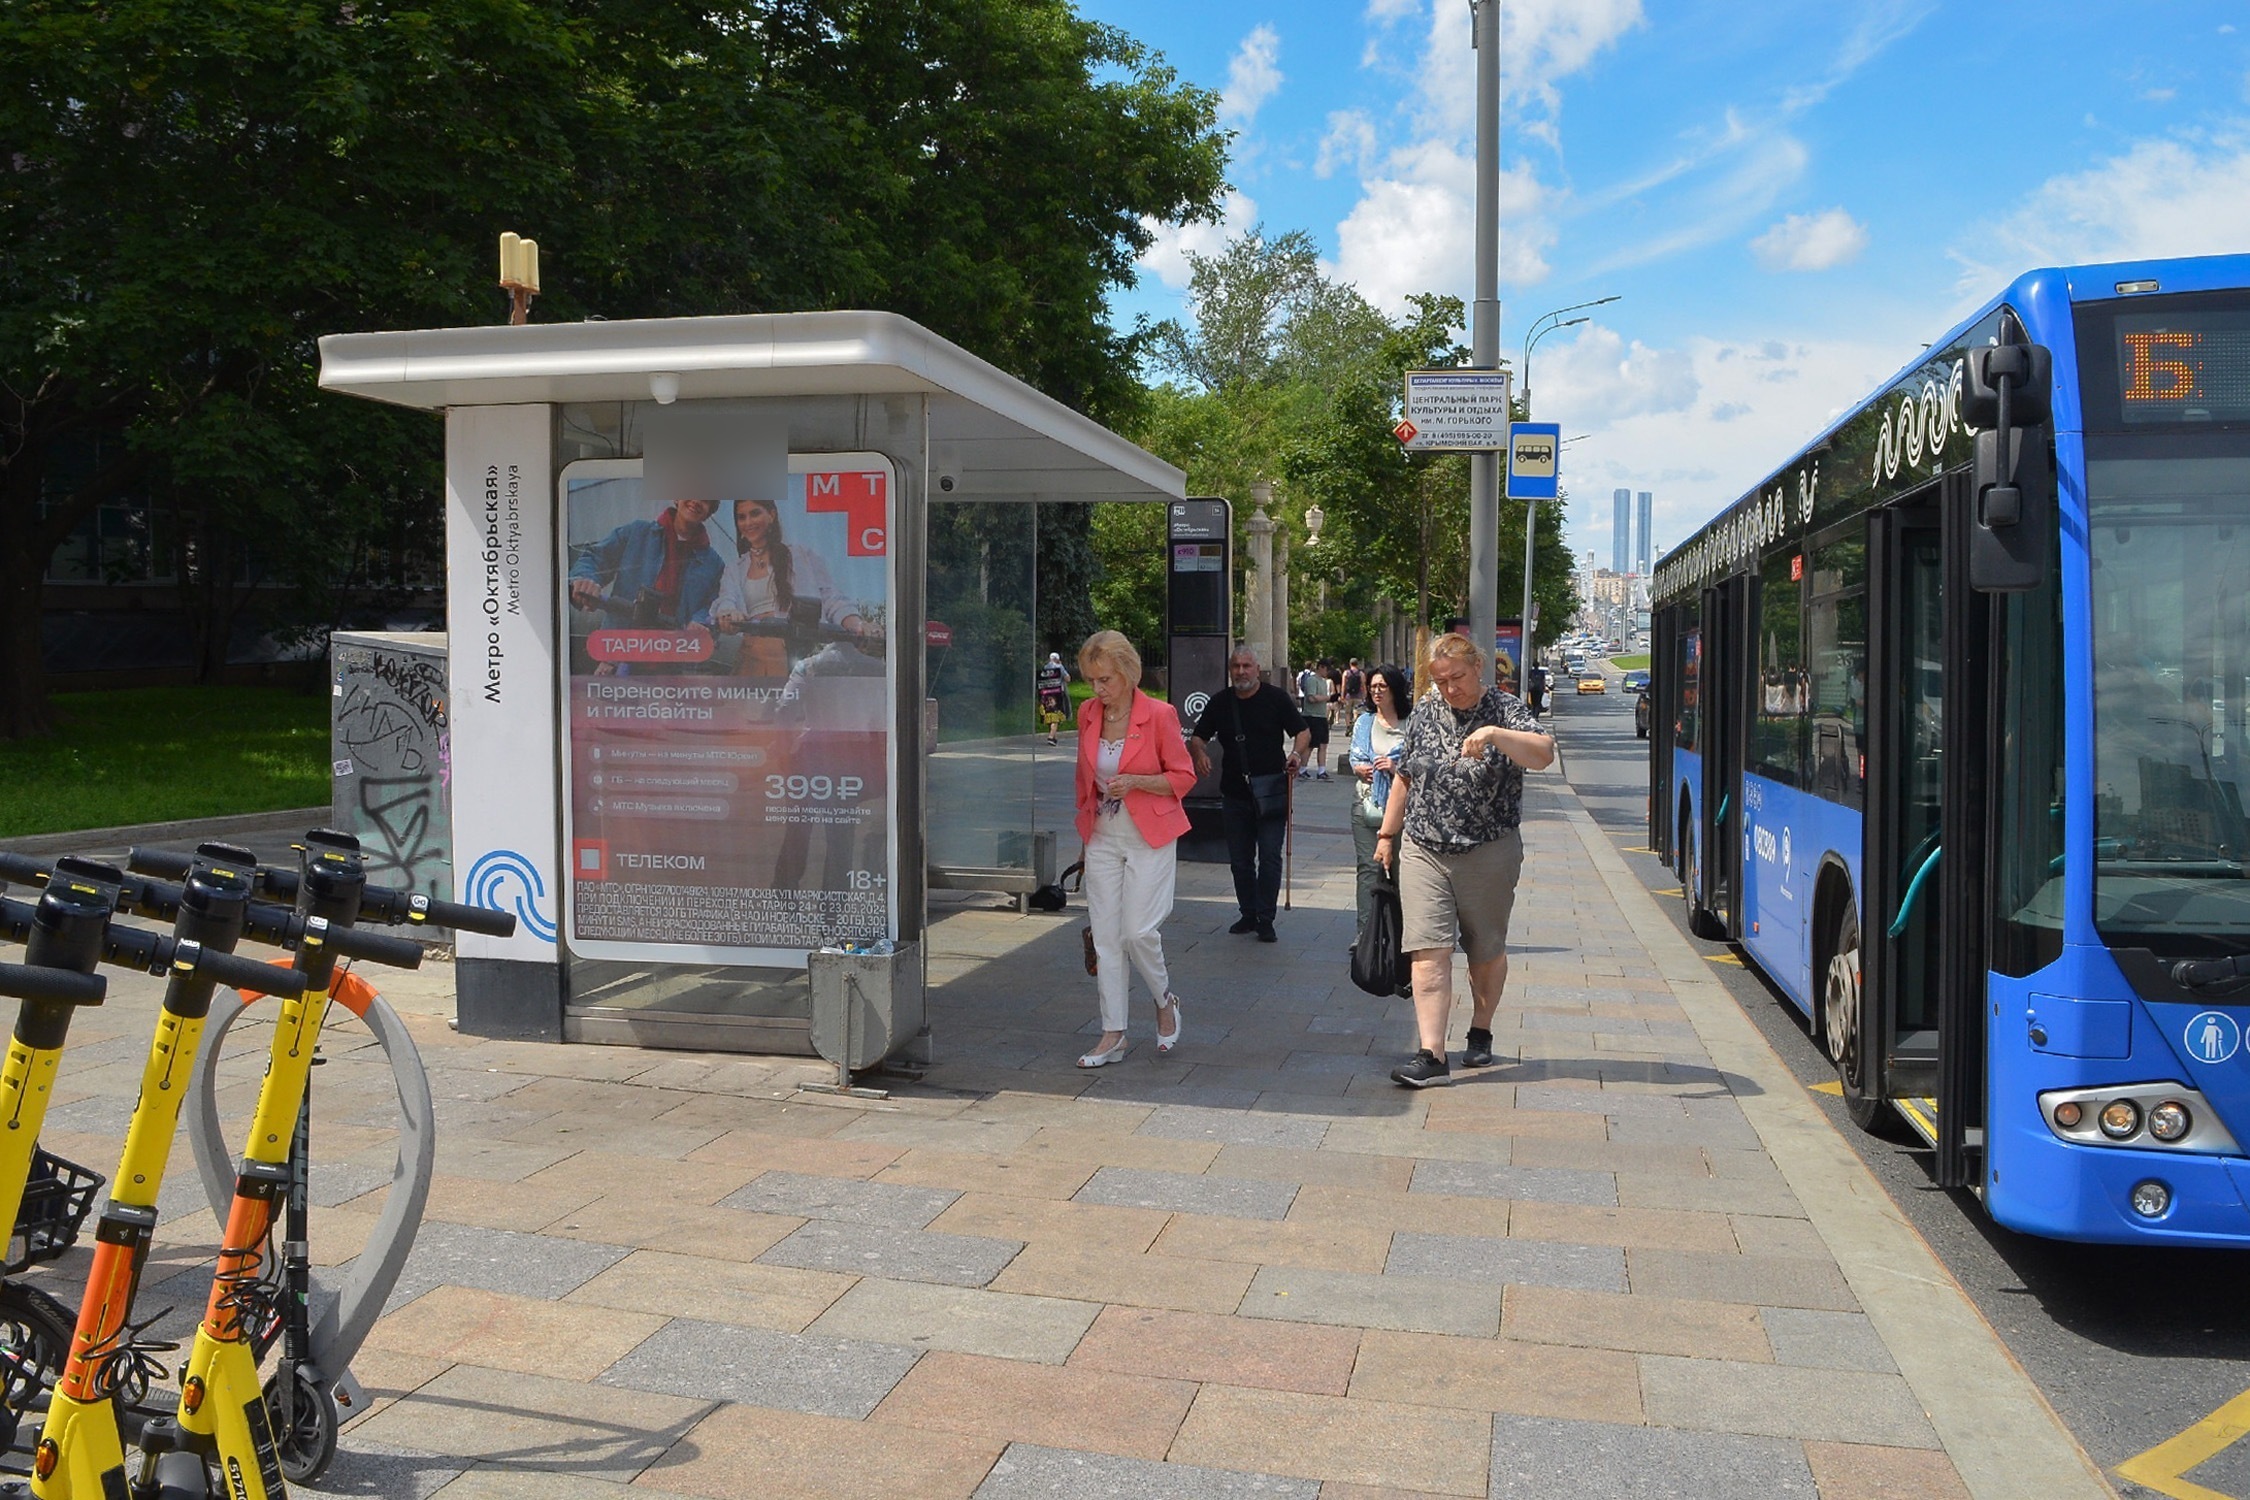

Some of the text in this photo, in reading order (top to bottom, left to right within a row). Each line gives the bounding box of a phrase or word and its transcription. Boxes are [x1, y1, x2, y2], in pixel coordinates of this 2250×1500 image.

[2125, 332, 2193, 399] Б
[1412, 394, 1502, 404] ЦЕНТРАЛЬНЫЙ ПАРК
[1411, 406, 1503, 415] КУЛЬТУРЫ И ОТДЫХА
[1447, 416, 1492, 424] ГОРЬКОГО
[505, 464, 522, 615] Metro Oktyabrskaya
[482, 464, 504, 703] Метро «Октябрьская»
[601, 638, 701, 653] ТАРИФ 24
[587, 682, 800, 703] Переносите минуты
[586, 702, 713, 720] и гигабайты
[765, 804, 871, 816] первый месяц, узнайте
[765, 815, 789, 824] цену
[801, 816, 820, 824] 2-го
[834, 816, 861, 824] сайте
[616, 853, 705, 870] ТЕЛЕКОМ
[577, 881, 595, 892] ПАО
[846, 869, 887, 890] 18+
[577, 892, 596, 903] ПРИ
[600, 893, 675, 906] ПОДКЛЮЧЕНИИ
[677, 896, 684, 906] И
[686, 897, 738, 909] ПЕРЕХОДЕ
[740, 899, 754, 910] НА
[819, 902, 827, 912] С
[828, 902, 886, 915] 23.05.2024
[577, 903, 662, 917] ПРЕДОСТАВЛЯЕТСЯ
[663, 906, 675, 917] 30
[675, 908, 687, 918] ГБ
[688, 908, 729, 920] ТРАФИКА
[867, 916, 886, 927] 300
[577, 914, 608, 925] МИНУТ
[750, 921, 803, 934] ГИГАБАЙТЫ
[803, 924, 871, 937] ПЕРЕНОСЯТСЯ
[577, 925, 636, 938] СЛЕДУЮЩИЙ
[636, 928, 668, 941] МЕСЯЦ
[743, 932, 800, 945] СТОИМОСТЬ
